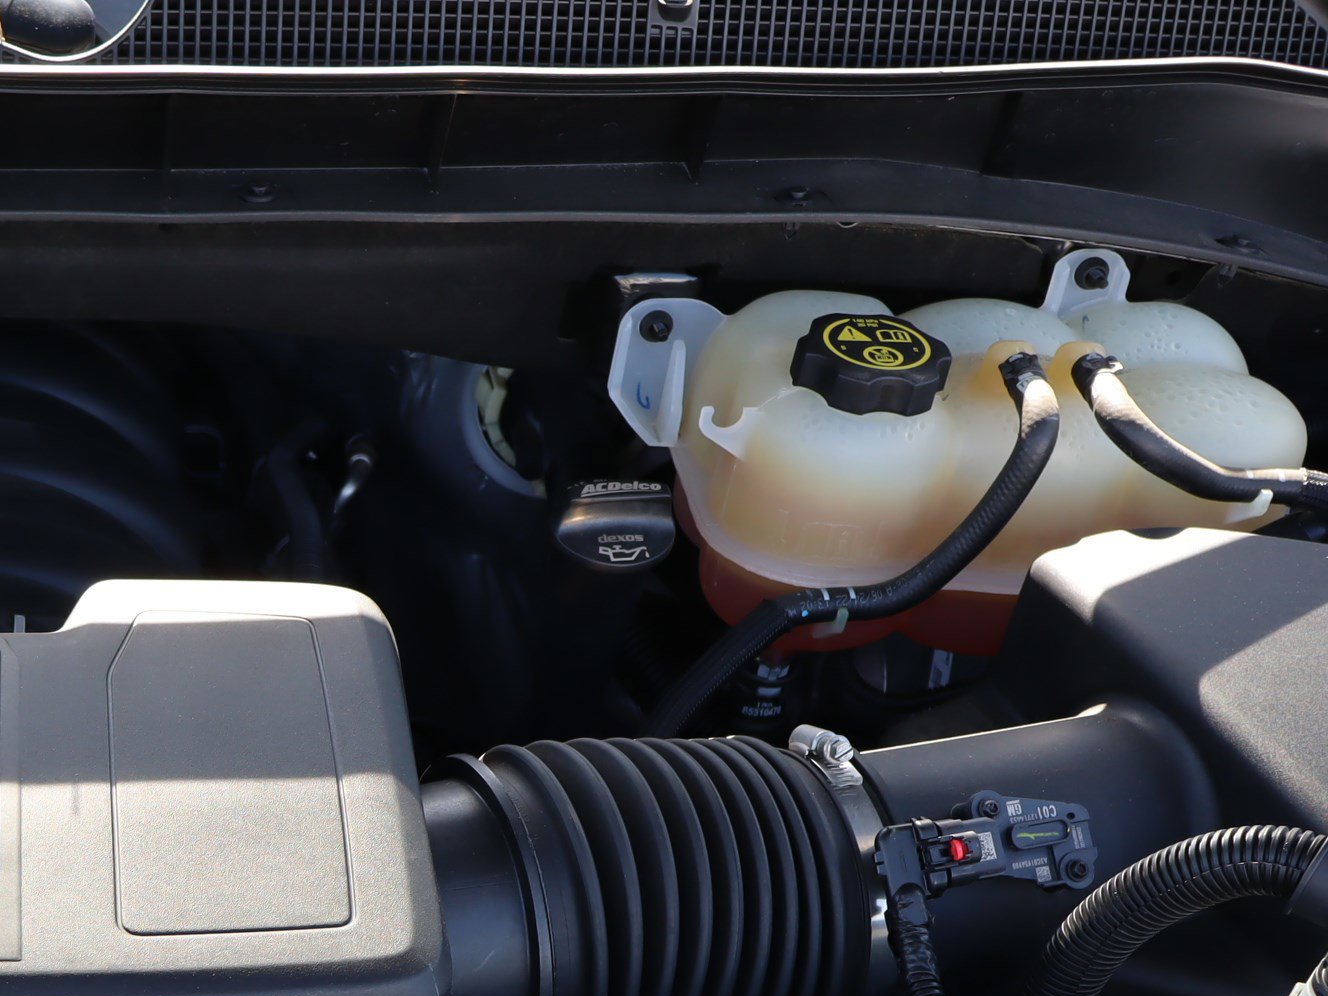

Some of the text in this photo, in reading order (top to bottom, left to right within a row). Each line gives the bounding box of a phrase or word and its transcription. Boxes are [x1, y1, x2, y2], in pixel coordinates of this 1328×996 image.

[580, 481, 662, 495] ACDelco
[597, 534, 645, 544] dexos
[1006, 803, 1023, 817] GM
[1037, 804, 1057, 820] C01
